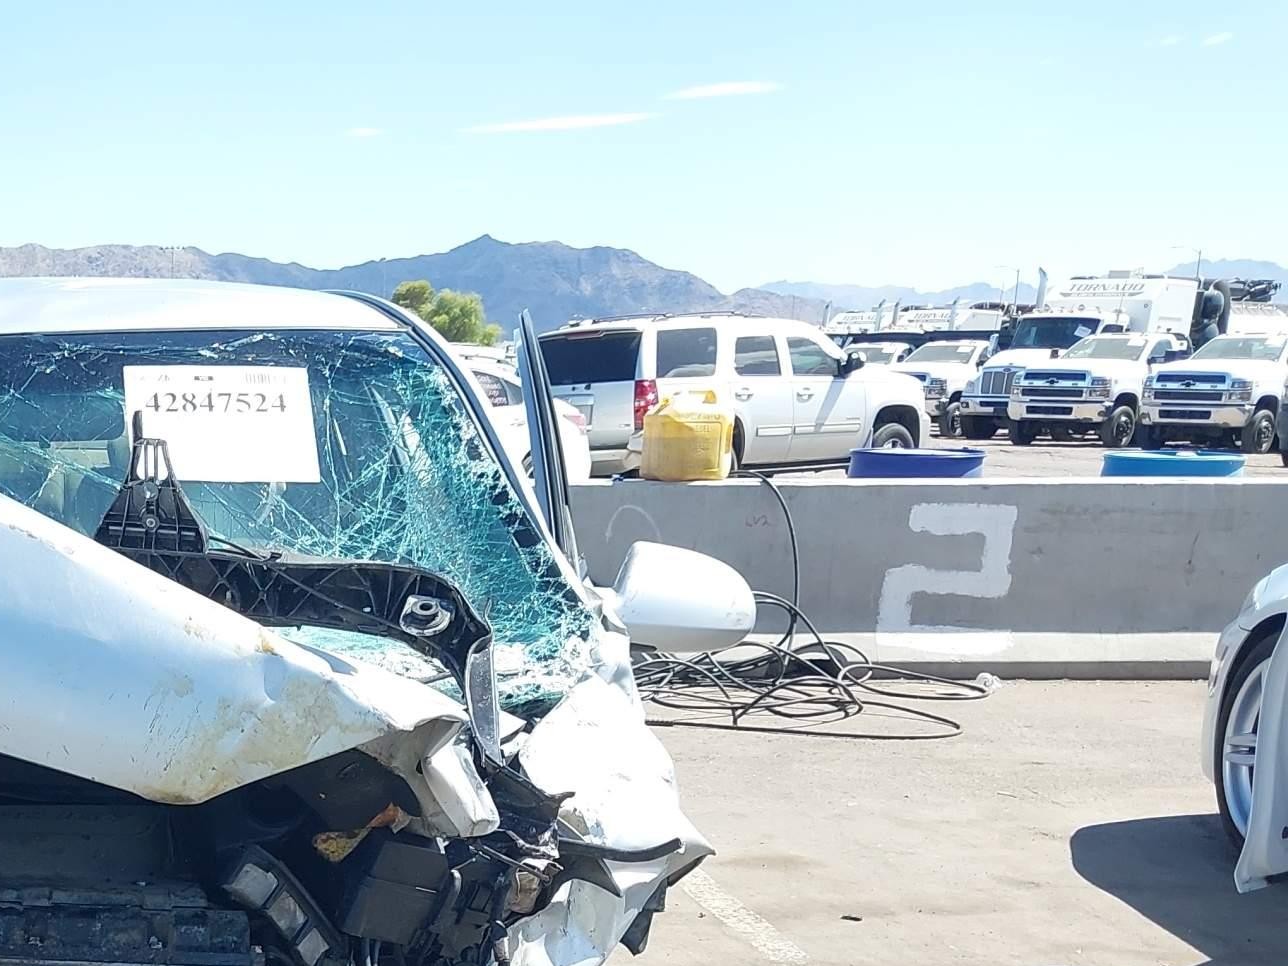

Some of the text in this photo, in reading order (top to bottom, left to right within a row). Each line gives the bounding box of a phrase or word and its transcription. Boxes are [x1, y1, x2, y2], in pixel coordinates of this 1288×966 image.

[1069, 283, 1145, 292] TORNADO
[145, 392, 287, 414] 42847524
[876, 502, 1018, 656] 2
